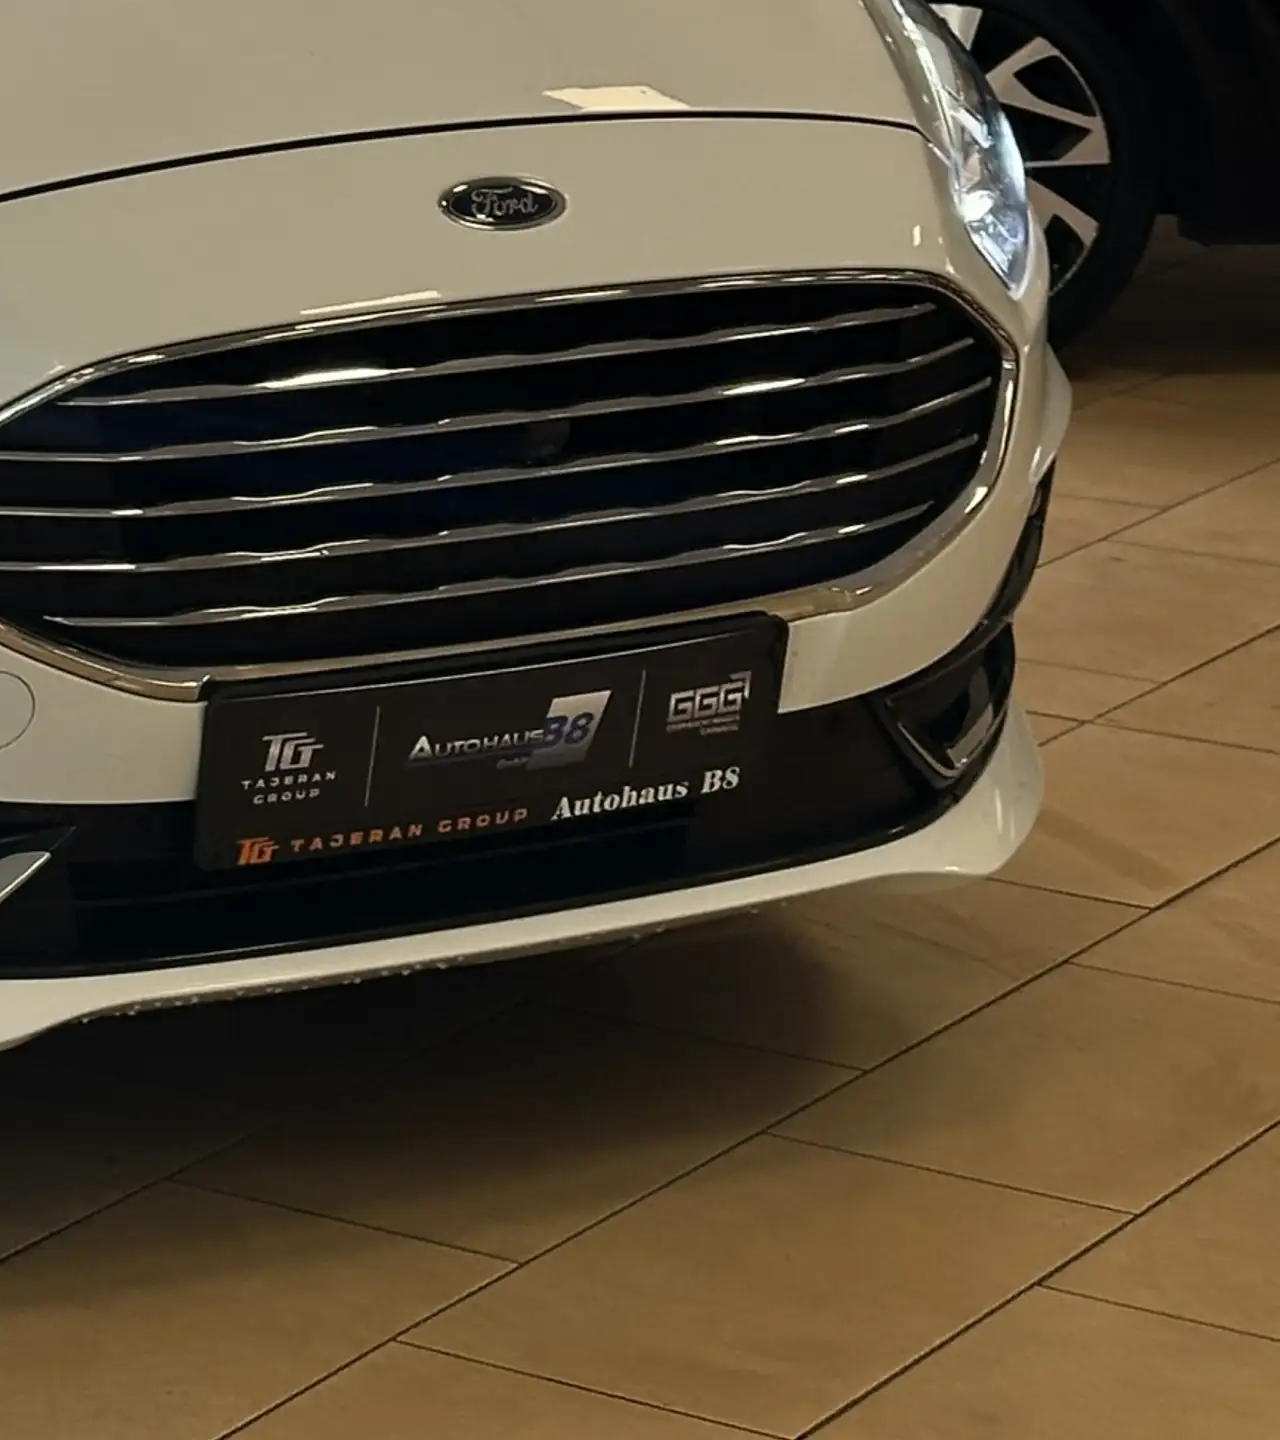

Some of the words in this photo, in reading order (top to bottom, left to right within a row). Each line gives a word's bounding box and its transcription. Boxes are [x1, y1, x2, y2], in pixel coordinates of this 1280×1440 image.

[471, 186, 539, 220] Ford
[667, 681, 743, 722] GGG
[240, 770, 337, 791] TAJERAN
[252, 787, 321, 806] GROUP
[290, 823, 424, 854] TAJERAN
[437, 807, 529, 834] GROUP
[550, 779, 690, 822] Autohaus
[700, 766, 741, 795] B8
